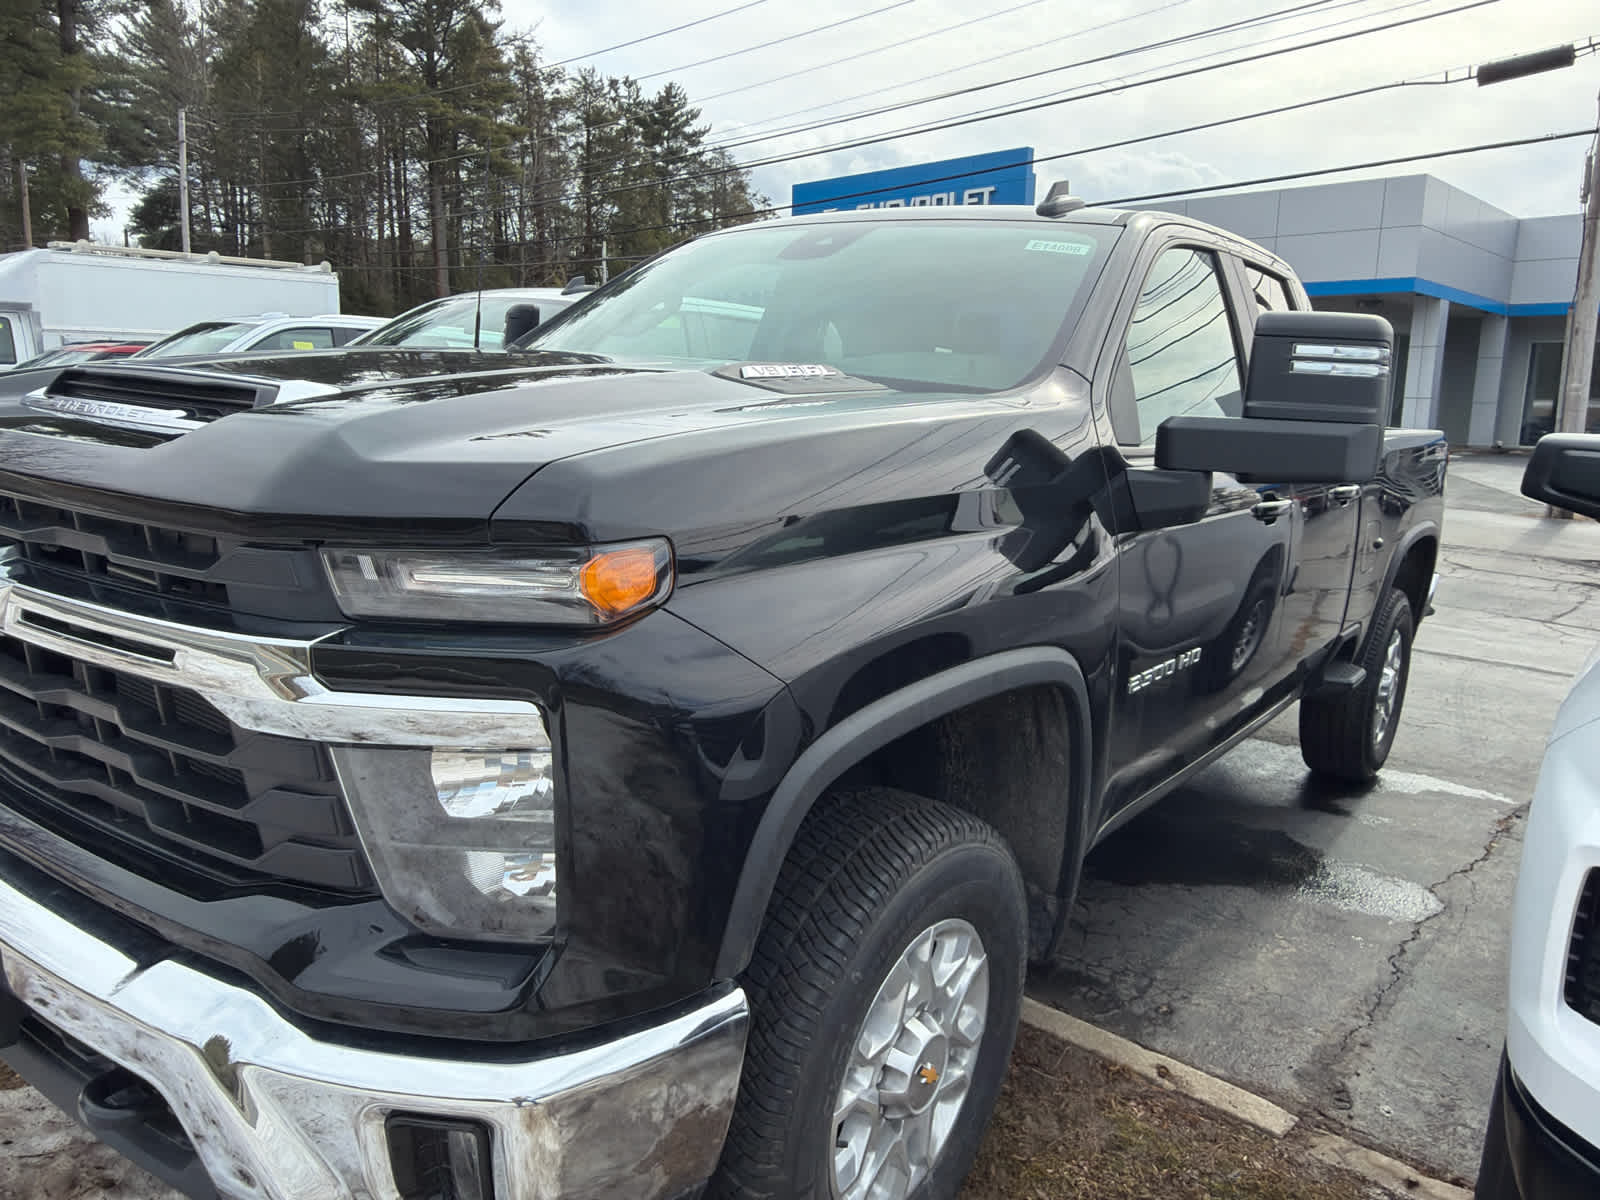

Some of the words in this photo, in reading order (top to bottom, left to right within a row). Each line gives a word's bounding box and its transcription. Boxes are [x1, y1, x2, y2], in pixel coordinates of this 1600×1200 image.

[856, 186, 995, 210] ROLET
[746, 365, 783, 377] V8
[1178, 647, 1202, 669] HD
